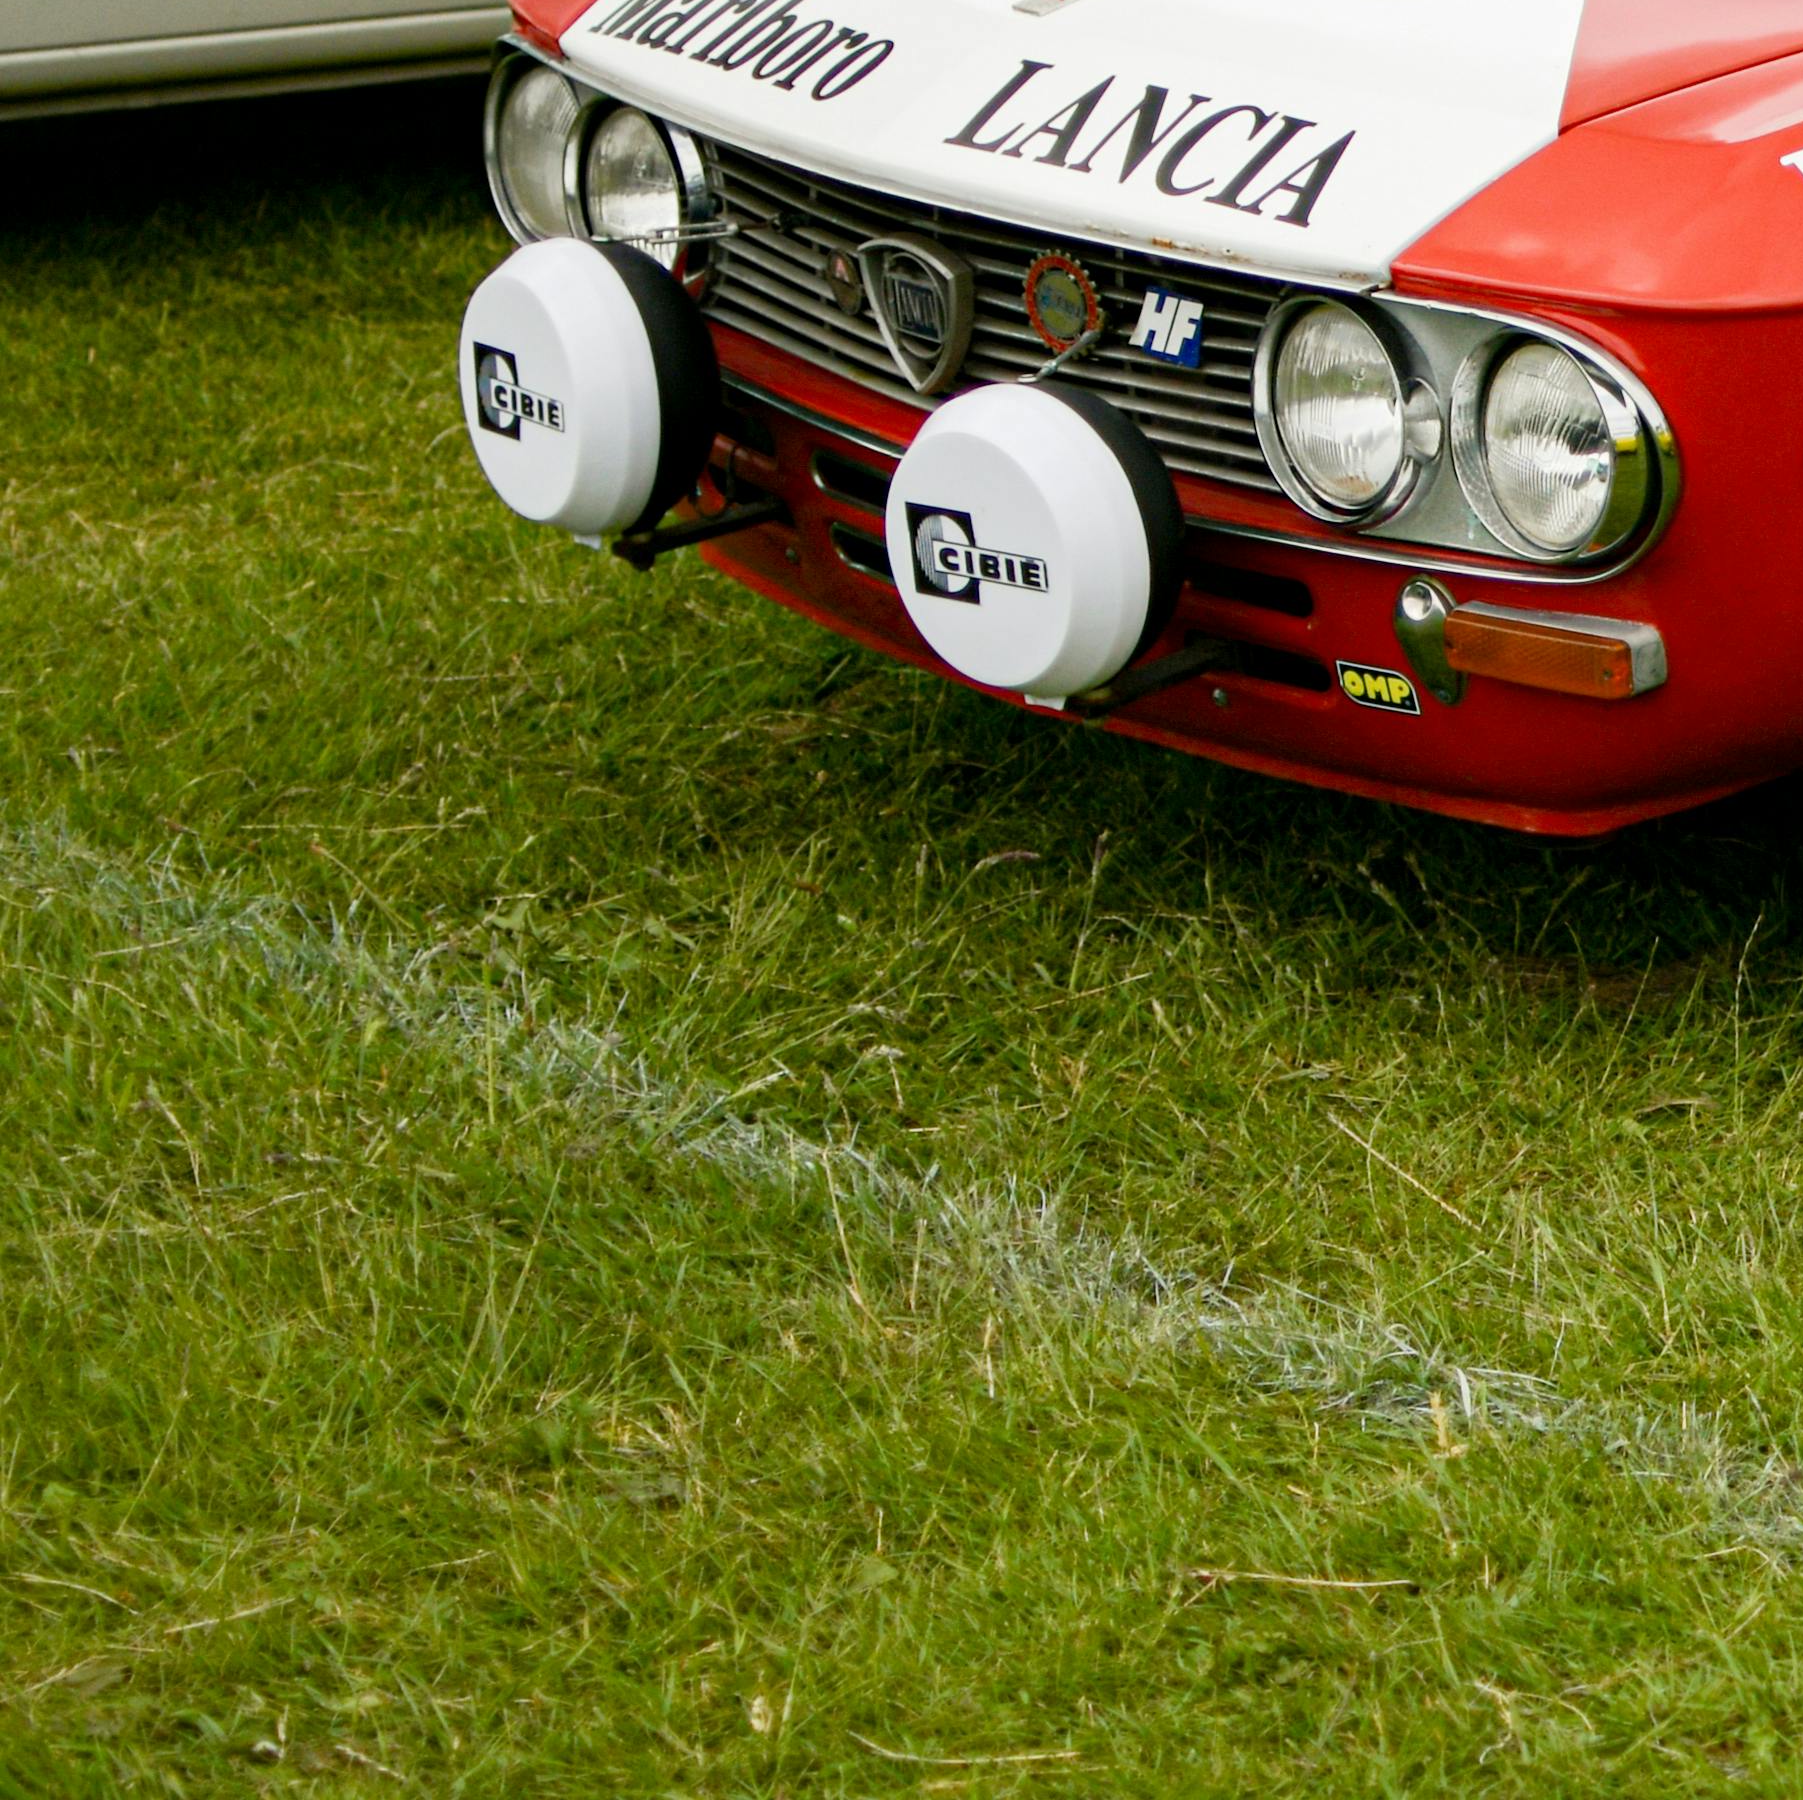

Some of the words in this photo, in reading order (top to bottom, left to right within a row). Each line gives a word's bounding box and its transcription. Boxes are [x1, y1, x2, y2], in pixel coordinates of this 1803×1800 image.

[944, 58, 1357, 228] LANCIA
[1128, 290, 1205, 358] HF
[1342, 669, 1411, 705] OMP
